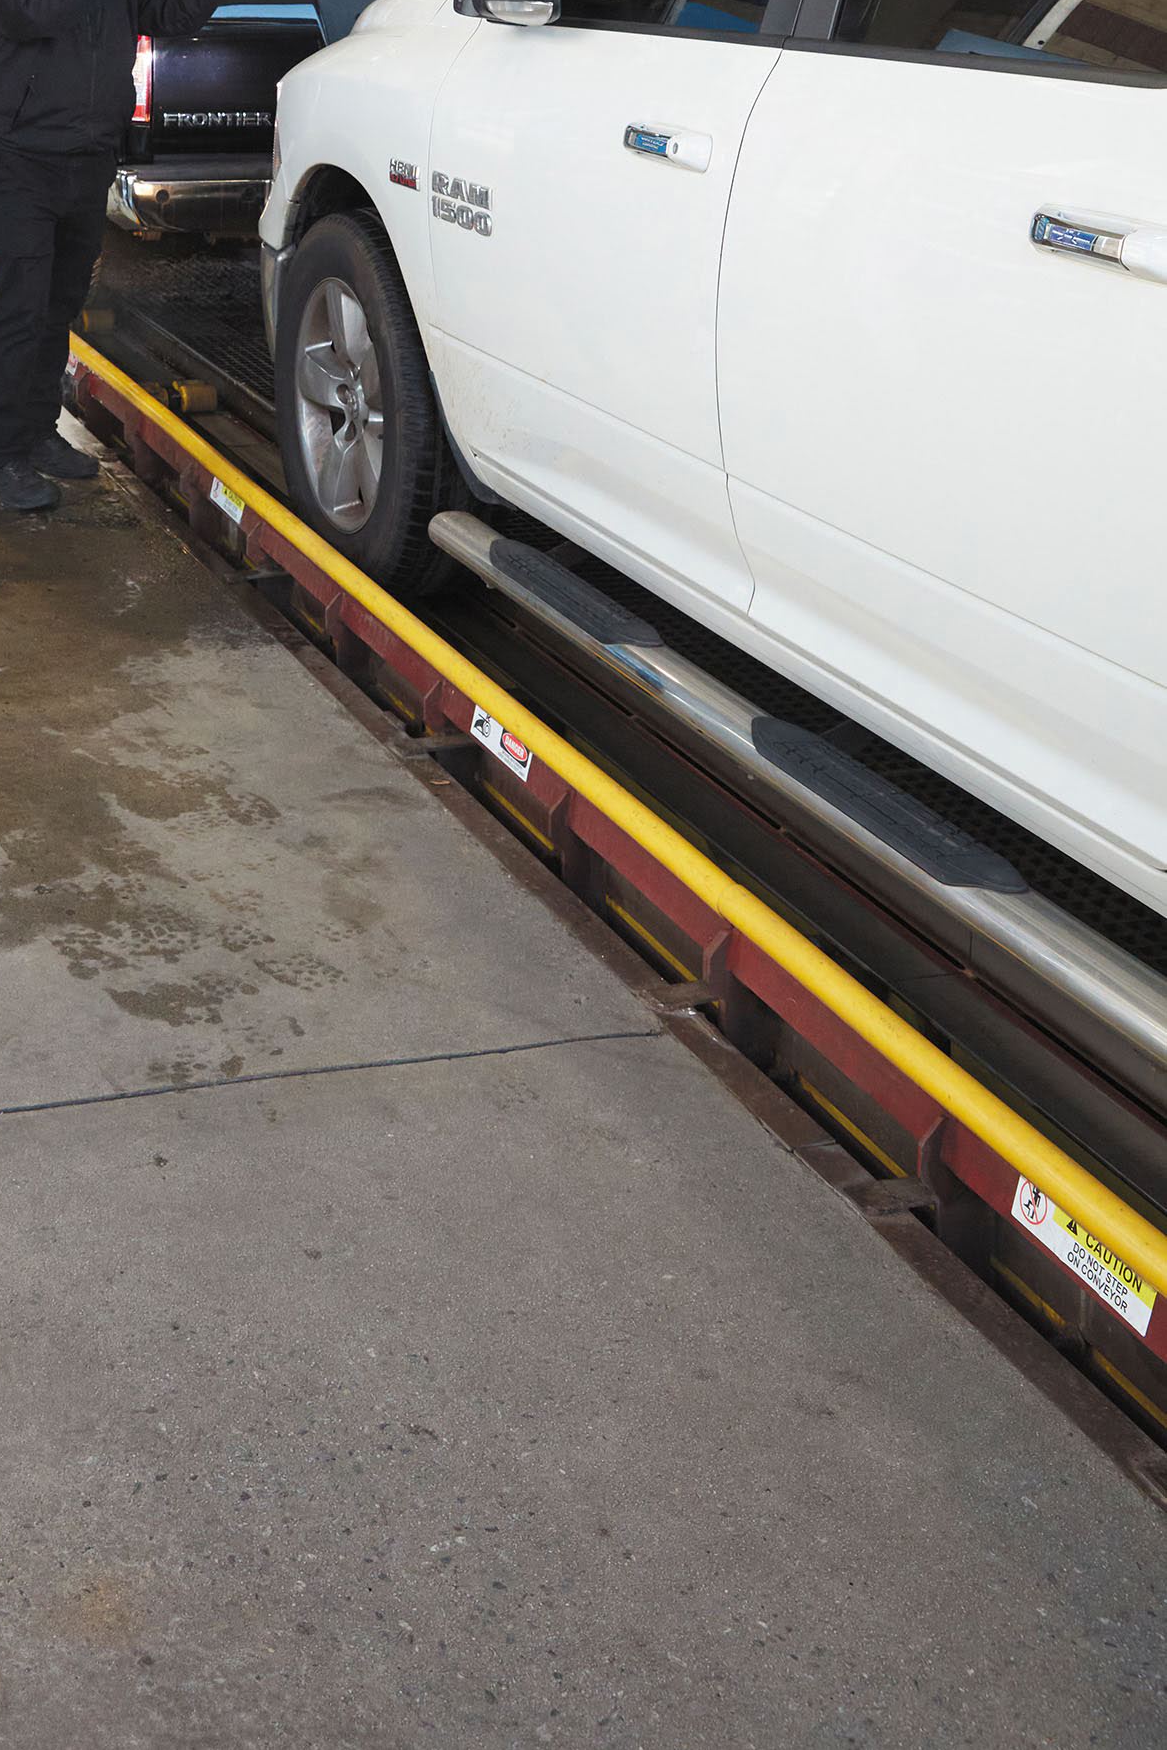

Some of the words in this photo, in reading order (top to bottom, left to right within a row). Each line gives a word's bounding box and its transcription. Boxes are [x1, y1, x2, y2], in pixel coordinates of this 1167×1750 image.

[163, 112, 272, 127] FRONTIER
[432, 170, 493, 210] RAM
[432, 195, 492, 237] 1500
[1067, 1252, 1082, 1271] ON
[1081, 1264, 1128, 1313] CONVEYOR
[1073, 1243, 1085, 1260] DO
[1087, 1255, 1105, 1276] NOT
[1106, 1272, 1128, 1296] STEP
[1085, 1234, 1143, 1293] CAUTION
